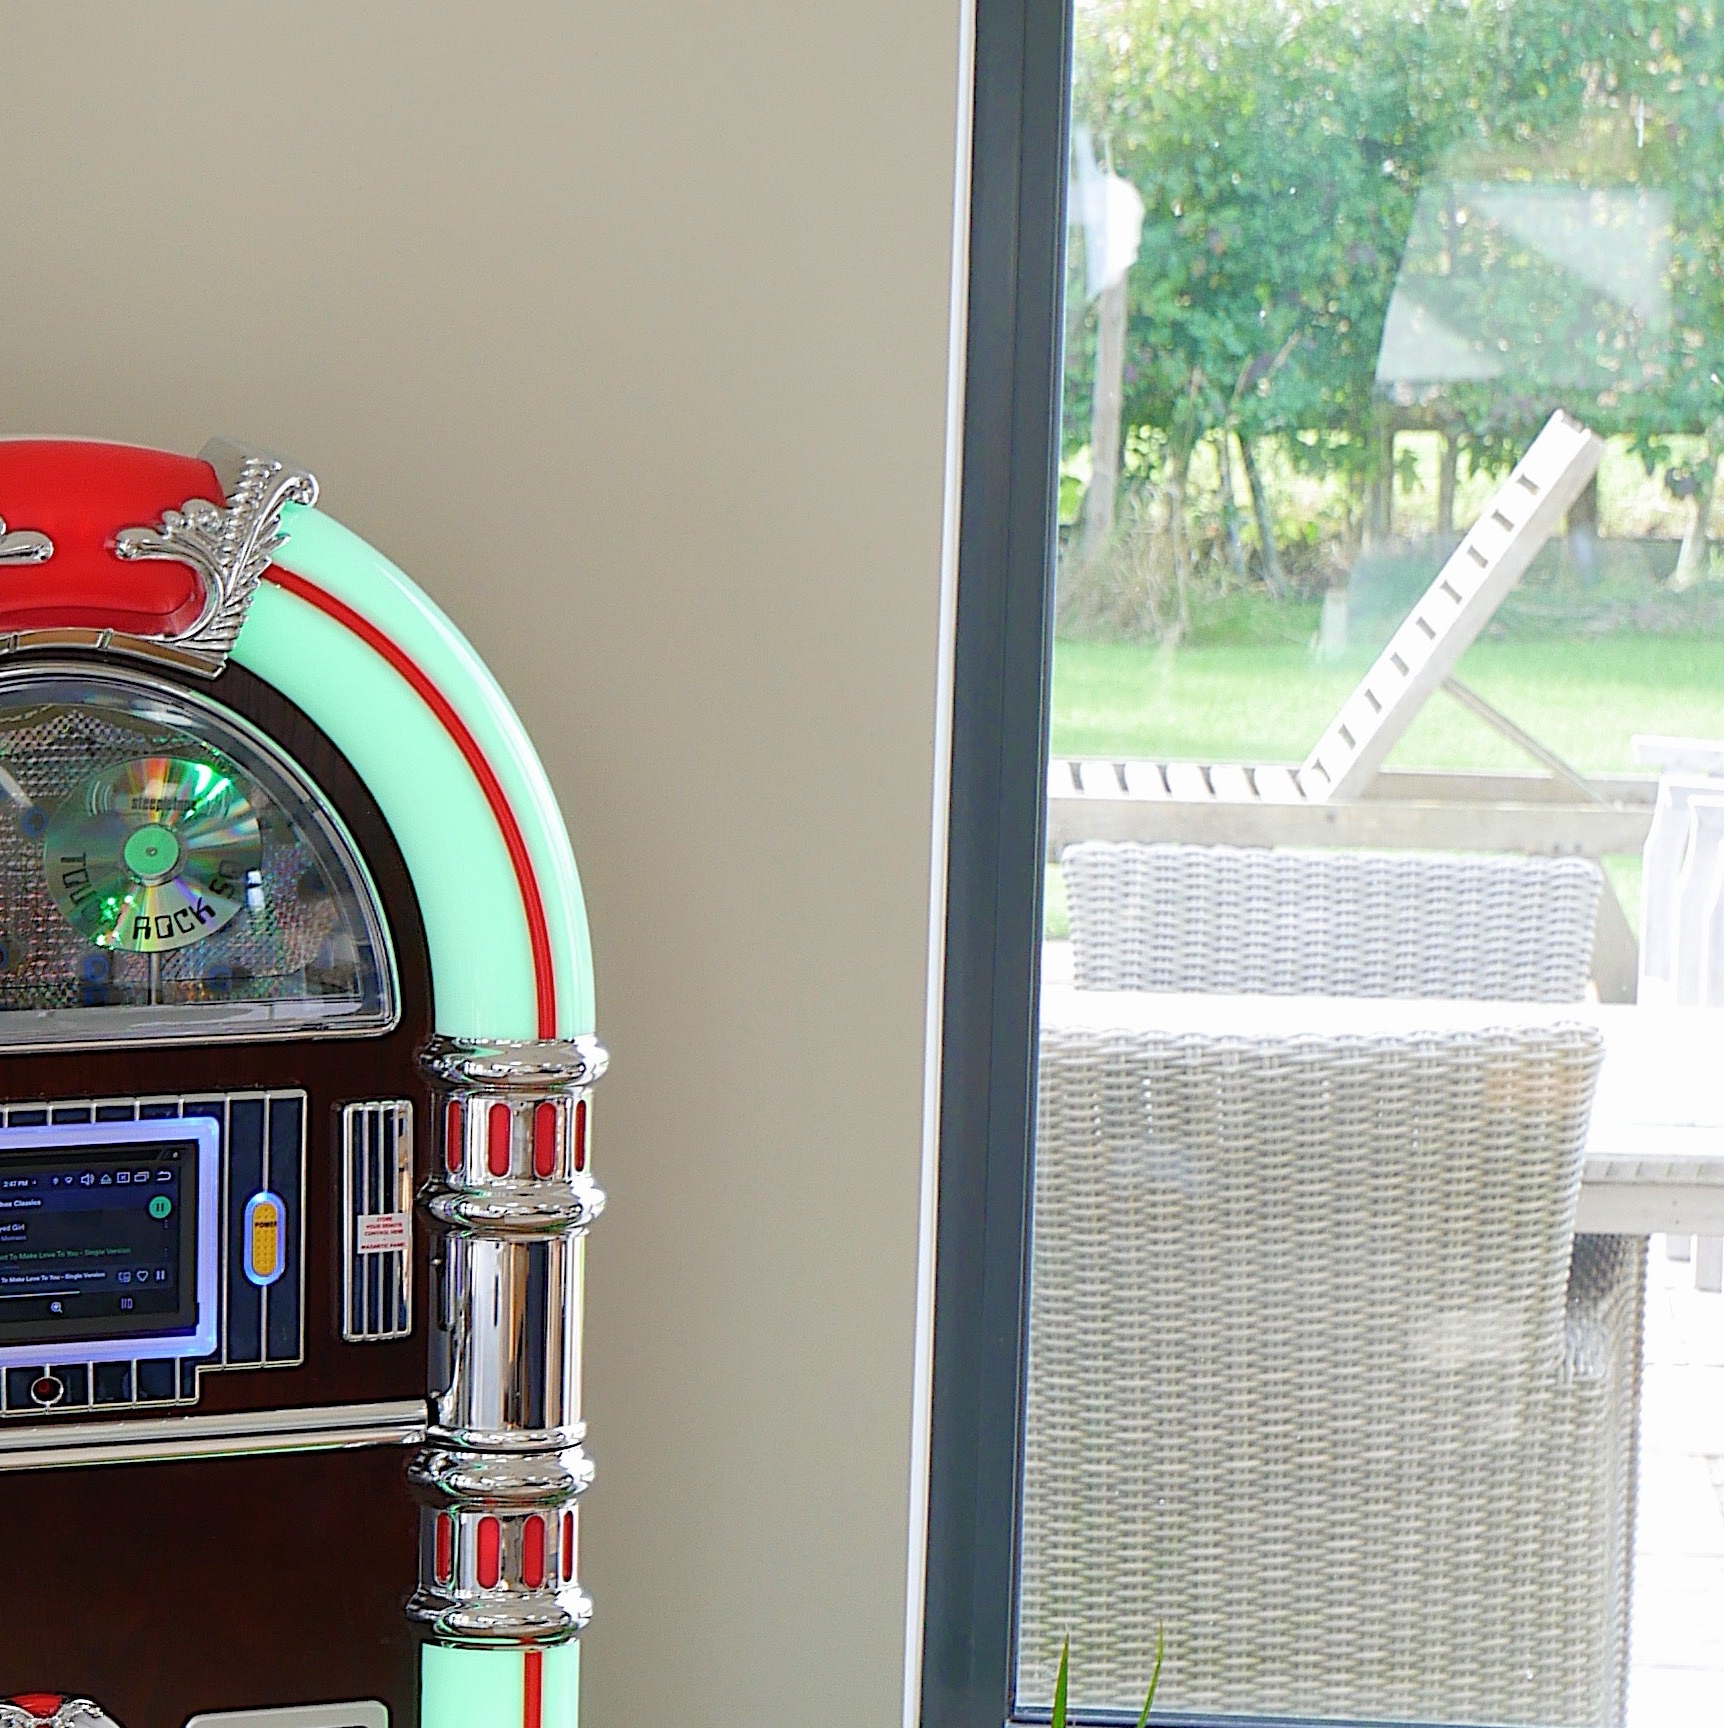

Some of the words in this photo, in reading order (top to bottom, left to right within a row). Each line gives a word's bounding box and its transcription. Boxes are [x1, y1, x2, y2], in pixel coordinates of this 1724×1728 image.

[133, 897, 216, 940] ROCK
[14, 1199, 41, 1207] Classics
[12, 1223, 25, 1231] Girl
